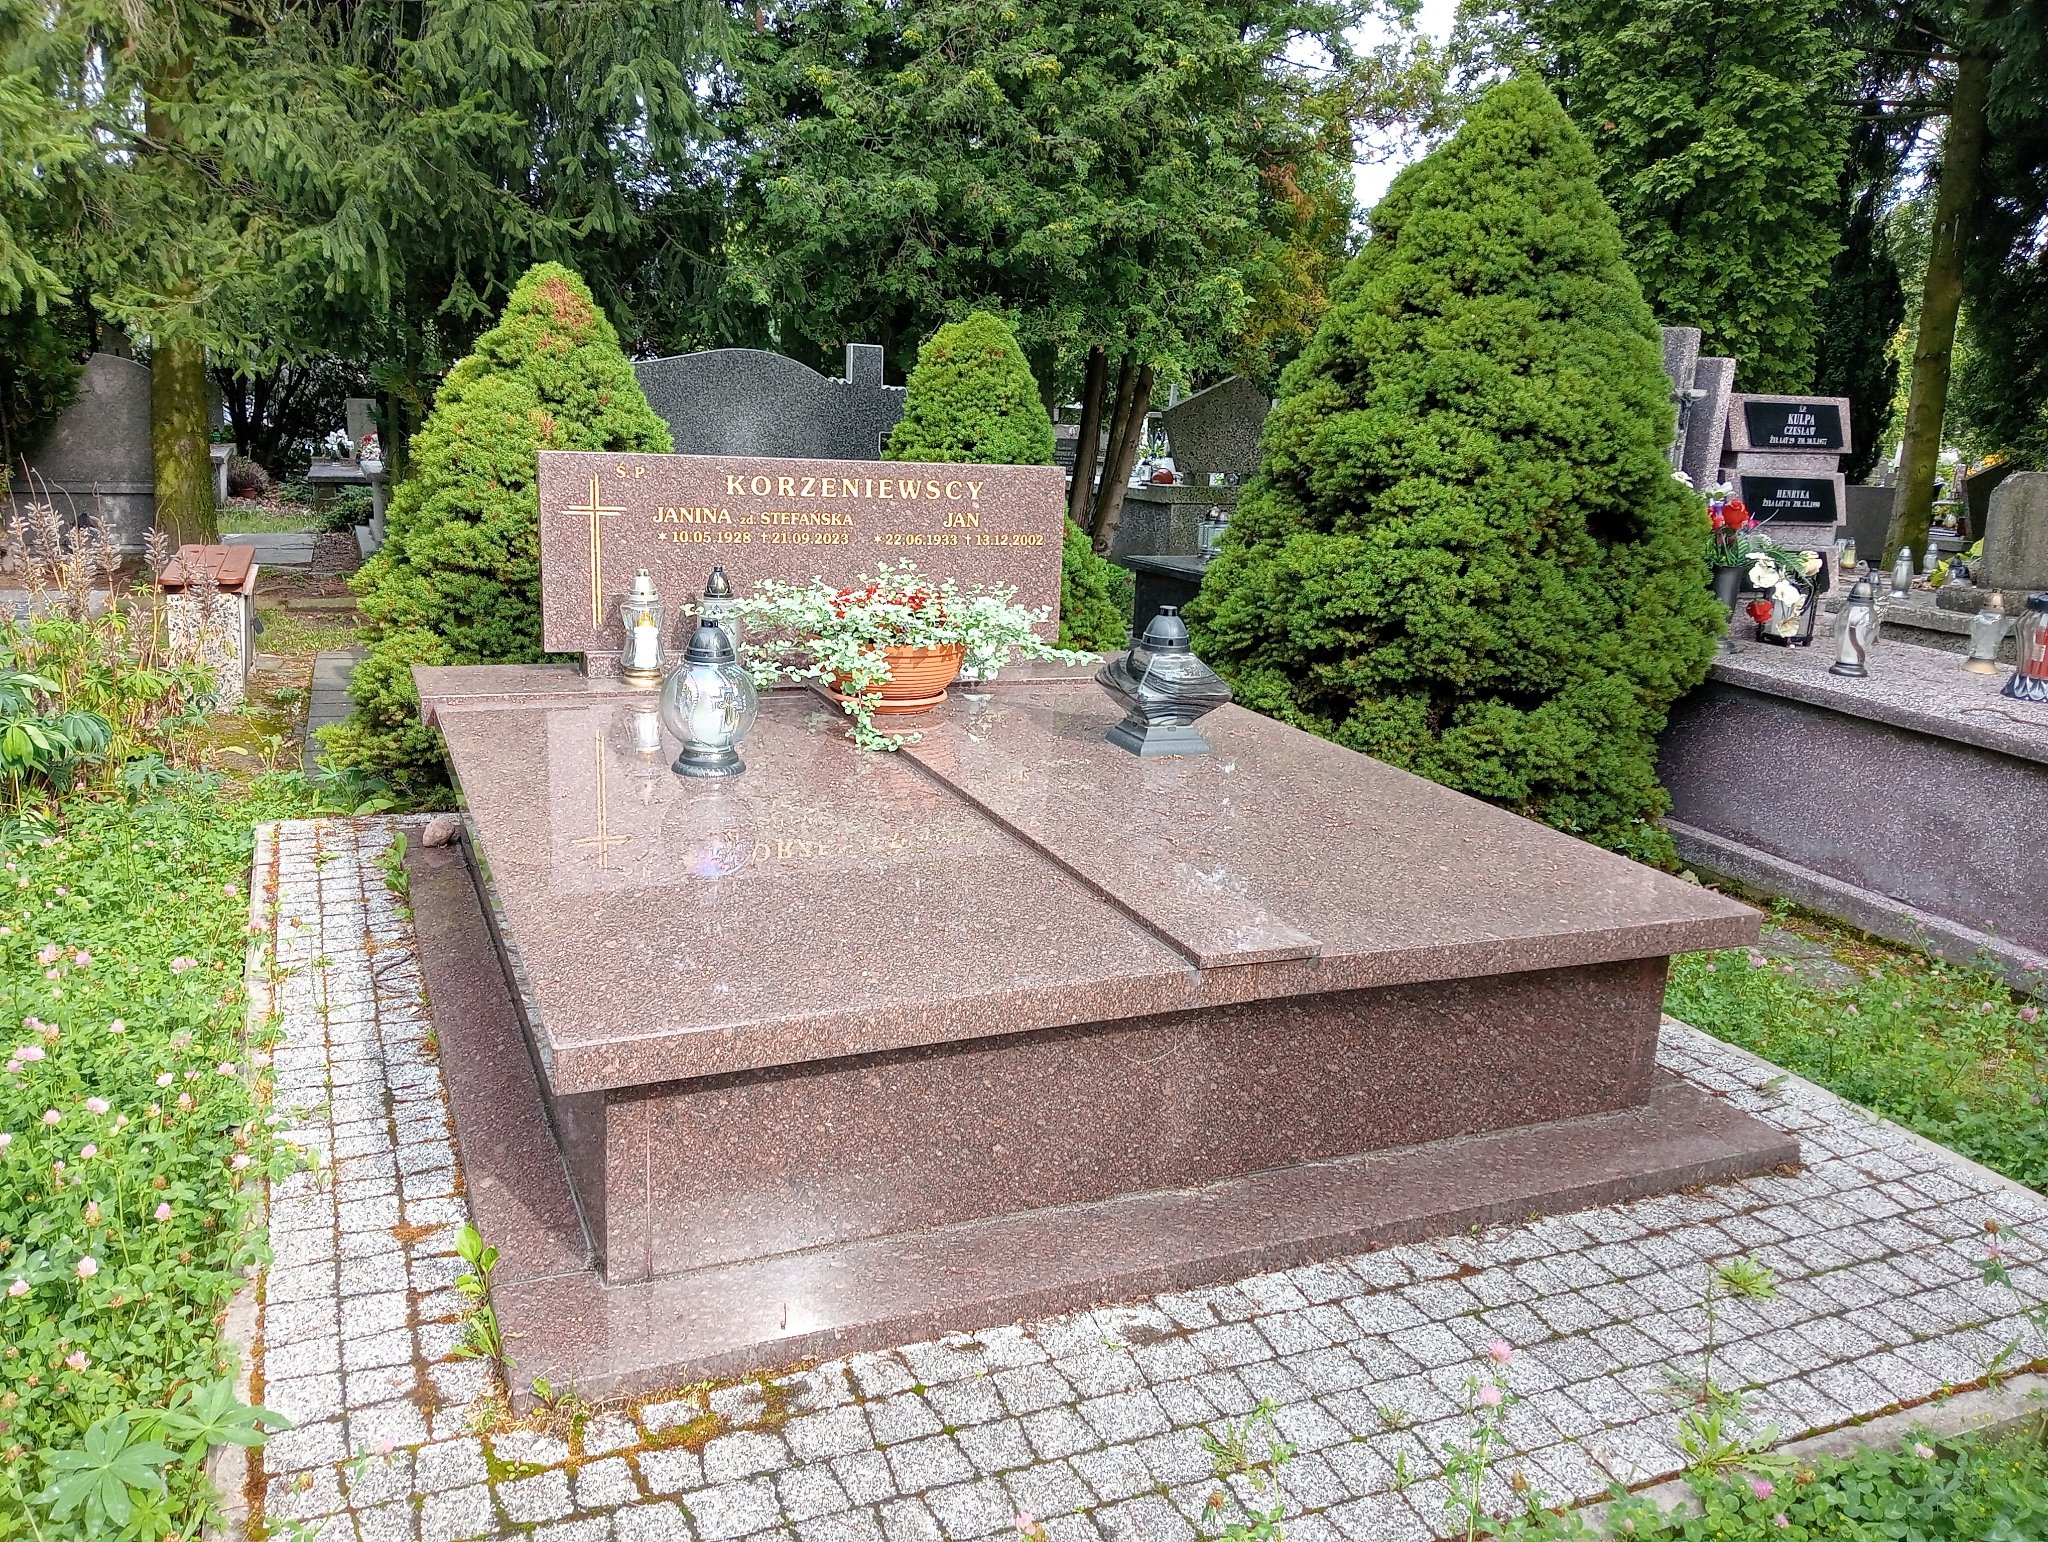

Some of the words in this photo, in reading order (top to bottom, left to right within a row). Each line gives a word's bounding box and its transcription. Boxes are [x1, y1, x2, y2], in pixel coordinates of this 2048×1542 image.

[1787, 413, 1815, 426] KULPA
[726, 474, 984, 501] KORZENIEWSCY
[1776, 489, 1810, 499] HENRYKA
[653, 506, 732, 525] JANINA
[739, 515, 757, 526] zd.
[760, 510, 854, 527] STEFAŃSKA
[943, 512, 980, 528] JAN
[672, 531, 752, 544] 10.05.1928
[772, 532, 849, 545] 21.09.2023
[886, 533, 958, 546] 22.06.1933
[975, 534, 1044, 547] 13.12.2002
